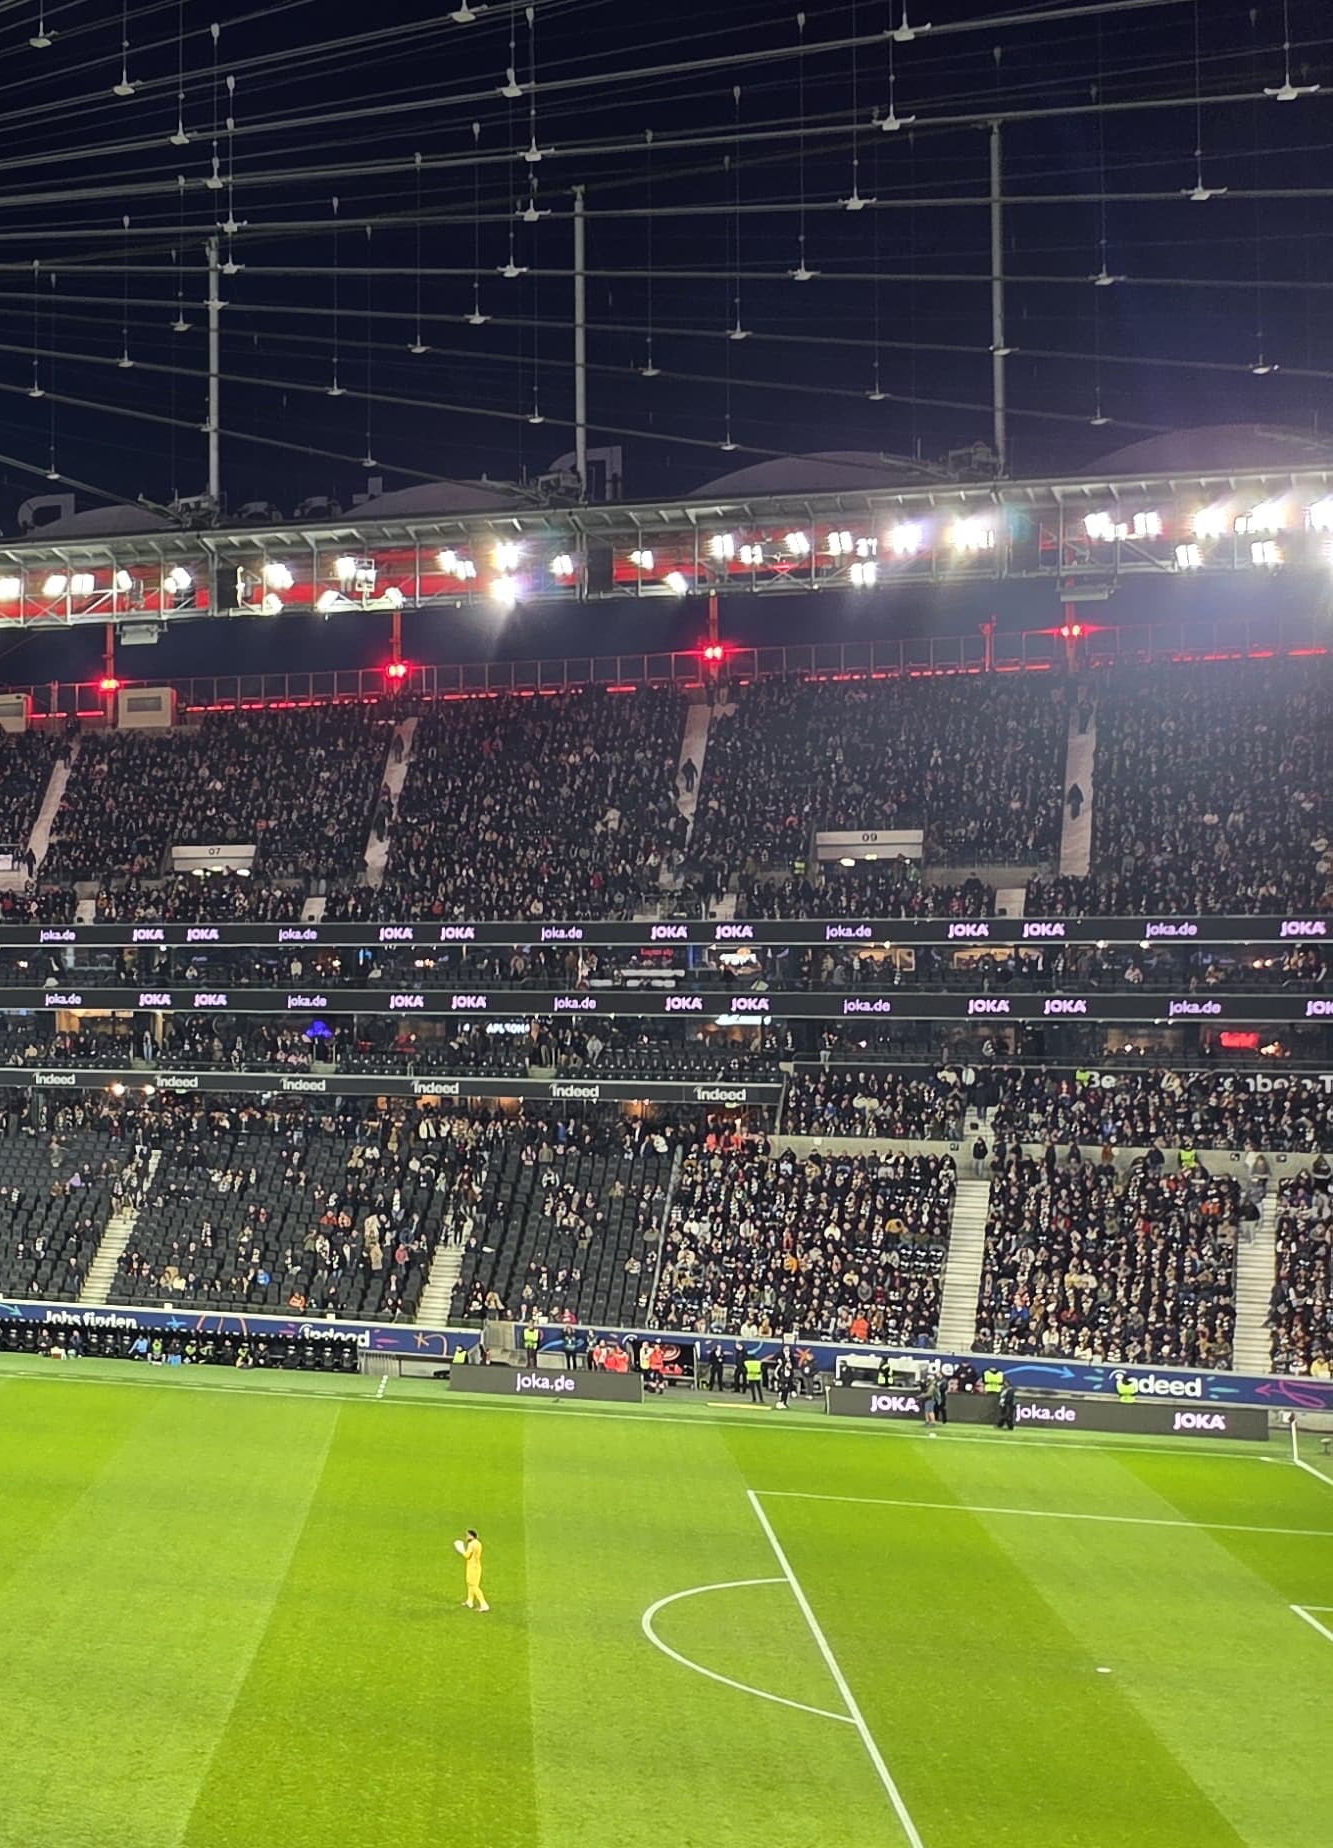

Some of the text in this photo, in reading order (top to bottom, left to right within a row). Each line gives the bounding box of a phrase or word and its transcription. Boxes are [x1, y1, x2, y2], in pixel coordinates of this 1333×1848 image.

[862, 833, 878, 842] 09
[208, 847, 221, 856] 07
[133, 929, 164, 942] JOKA
[187, 929, 219, 941] JOKA
[279, 929, 317, 941] joka.de
[379, 928, 413, 941] JOKA
[441, 927, 474, 940] JOKA
[541, 927, 582, 941] joka.de
[651, 926, 687, 939] JOKA
[715, 926, 753, 939] JOKA
[826, 925, 871, 939] joka.de
[948, 924, 989, 938] JOKA
[1023, 923, 1064, 937] JOKA
[1146, 923, 1197, 938] joka.de
[1280, 921, 1326, 936] JOKA
[139, 994, 171, 1006] JOKA
[194, 994, 227, 1007] JOKA
[288, 995, 326, 1008] joka.de
[390, 995, 423, 1009] JOKA
[452, 996, 486, 1009] JOKA
[554, 997, 596, 1011] joka.de
[665, 997, 702, 1011] JOKA
[731, 998, 769, 1011] JOKA
[844, 999, 890, 1013] joka.de
[968, 1000, 1009, 1014] JOKA
[1044, 1000, 1086, 1014] JOKA
[1169, 1000, 1221, 1016] joka.de
[34, 1072, 75, 1086] indeed
[155, 1074, 198, 1088] indeed
[282, 1078, 326, 1092] indeed
[410, 1080, 459, 1095] indeed
[549, 1083, 599, 1099] indeed
[693, 1086, 746, 1101] indeed
[516, 1373, 574, 1392] joka.de
[870, 1395, 1225, 1431] JOKA joka.de JOKA
